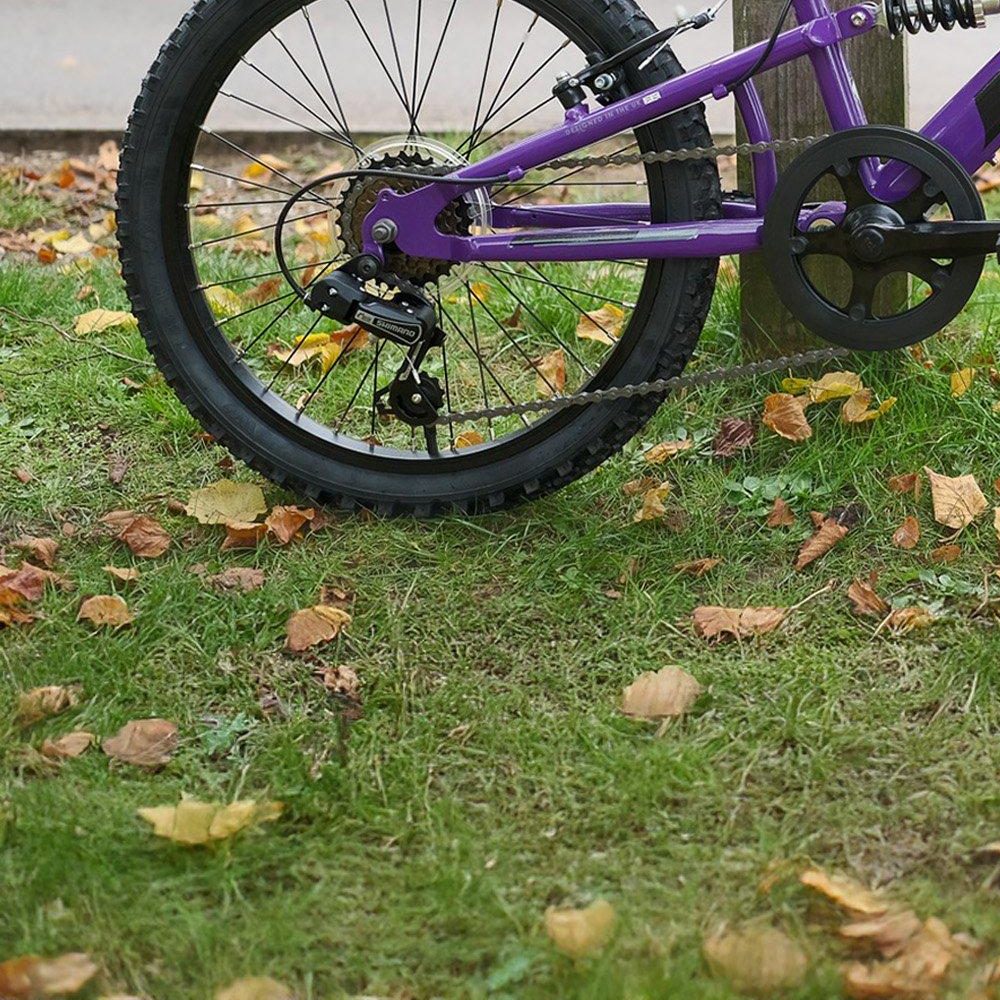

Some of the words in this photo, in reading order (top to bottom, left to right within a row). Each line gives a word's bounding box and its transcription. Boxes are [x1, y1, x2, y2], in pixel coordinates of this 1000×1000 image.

[566, 116, 603, 135] DESIGNED
[616, 105, 630, 115] THE
[376, 320, 415, 337] SHIMANO
